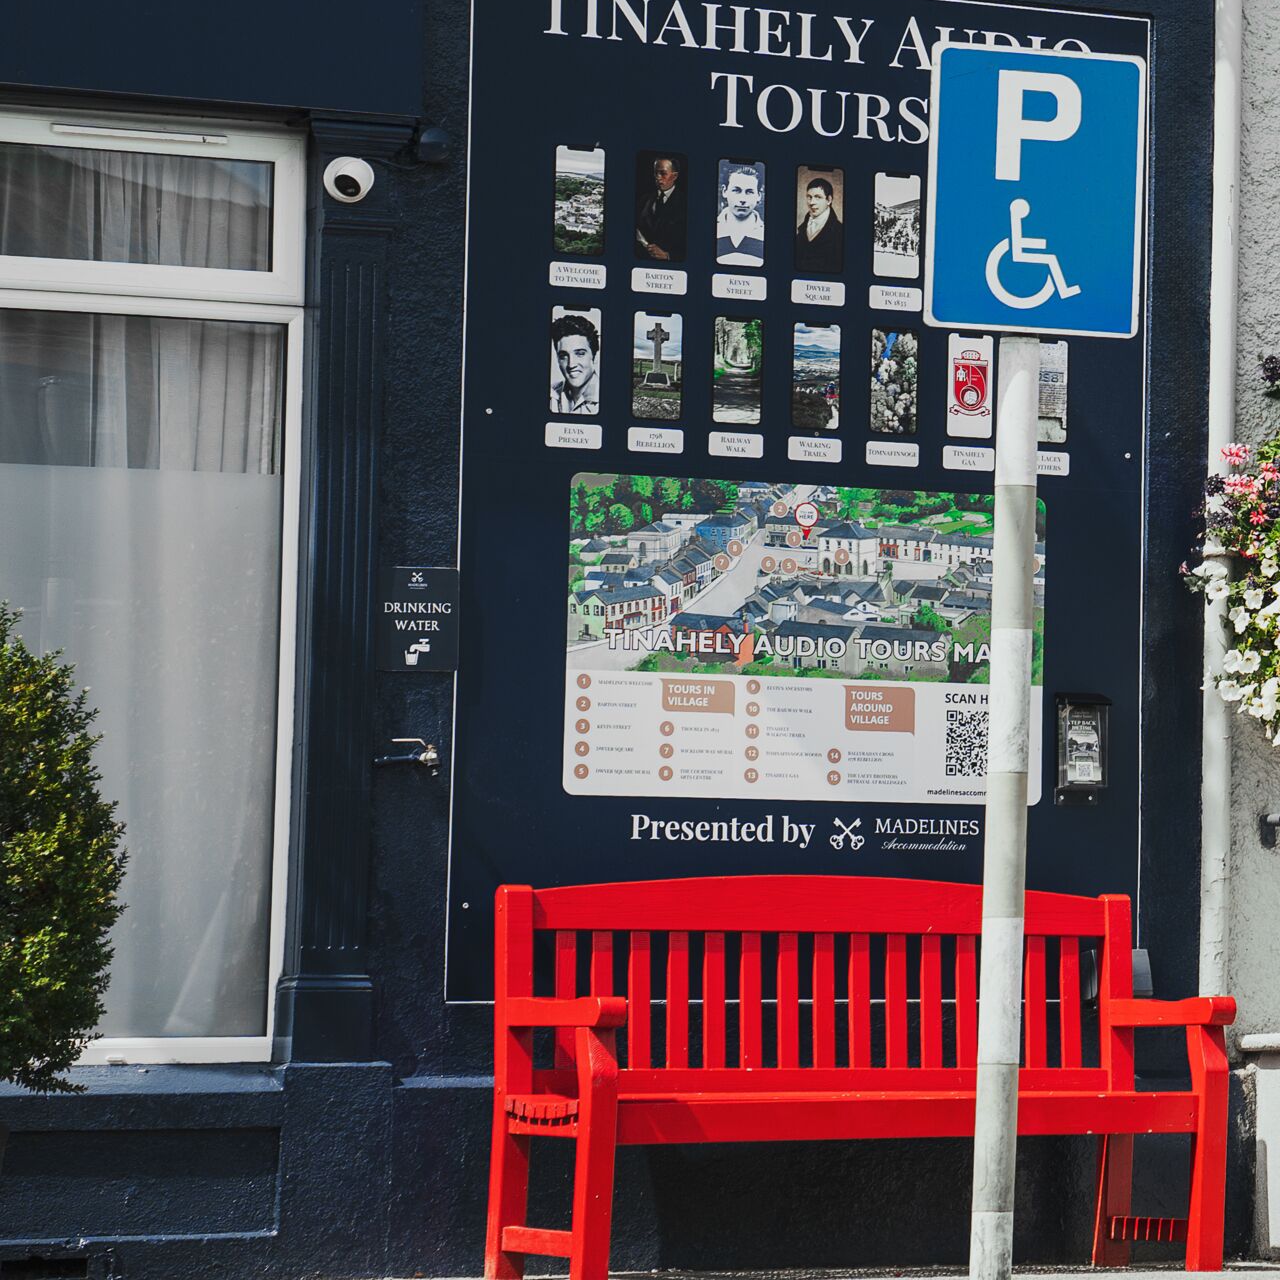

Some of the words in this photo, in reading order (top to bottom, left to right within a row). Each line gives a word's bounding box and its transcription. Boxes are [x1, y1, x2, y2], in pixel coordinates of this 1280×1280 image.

[711, 72, 929, 144] TOURS
[995, 70, 1082, 181] P
[645, 273, 674, 281] BARTON
[645, 281, 673, 290] STREET
[726, 287, 752, 296] STREET
[564, 427, 584, 435] ELVIS
[558, 436, 589, 444] PRESLEY
[636, 440, 675, 449] REBELLION
[720, 436, 752, 444] RAILWAY
[799, 441, 831, 449] WALKING
[725, 445, 746, 453] WALK
[803, 450, 827, 458] TRAILS
[384, 602, 452, 614] DRINKING
[395, 620, 440, 631] WATER
[603, 628, 747, 655] TINAHELY
[752, 634, 847, 659] AUDIO
[853, 638, 947, 662] TOURS
[953, 641, 991, 663] MA
[668, 684, 702, 695] TOURS
[703, 685, 715, 695] IN
[851, 690, 883, 701] TOURS
[944, 693, 977, 705] SCAN
[668, 697, 709, 707] VILLAGE
[850, 703, 893, 713] AROUND
[850, 715, 890, 725] VILLAGE
[926, 788, 987, 797] madelinesaccom
[630, 813, 774, 843] Presented
[782, 816, 816, 849] by
[874, 818, 980, 836] MADELINES
[881, 837, 967, 851] Accommodation
